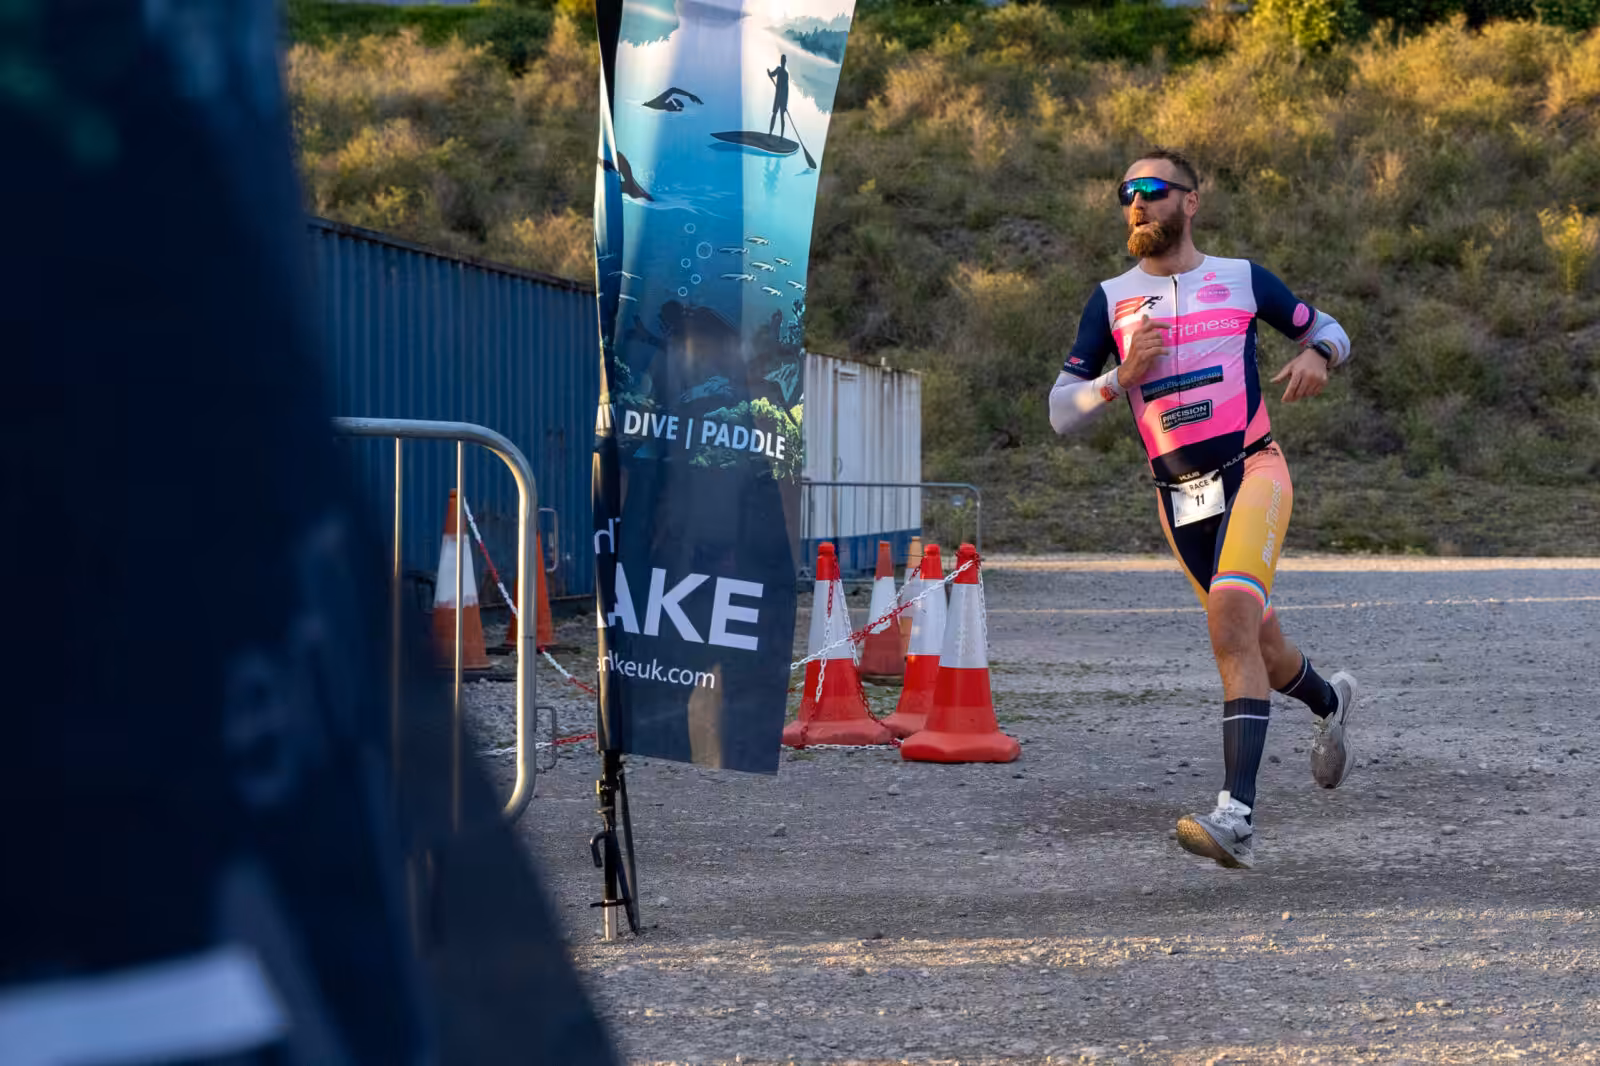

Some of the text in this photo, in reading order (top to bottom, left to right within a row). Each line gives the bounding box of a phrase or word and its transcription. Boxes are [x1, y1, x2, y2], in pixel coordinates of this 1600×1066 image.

[1168, 319, 1240, 338] Fitness
[1162, 405, 1207, 423] PRECISION
[623, 409, 680, 441] DIVE
[701, 420, 786, 460] PADDLE
[1188, 480, 1210, 491] RACE
[1195, 493, 1205, 507] 11
[607, 562, 765, 650] AKE
